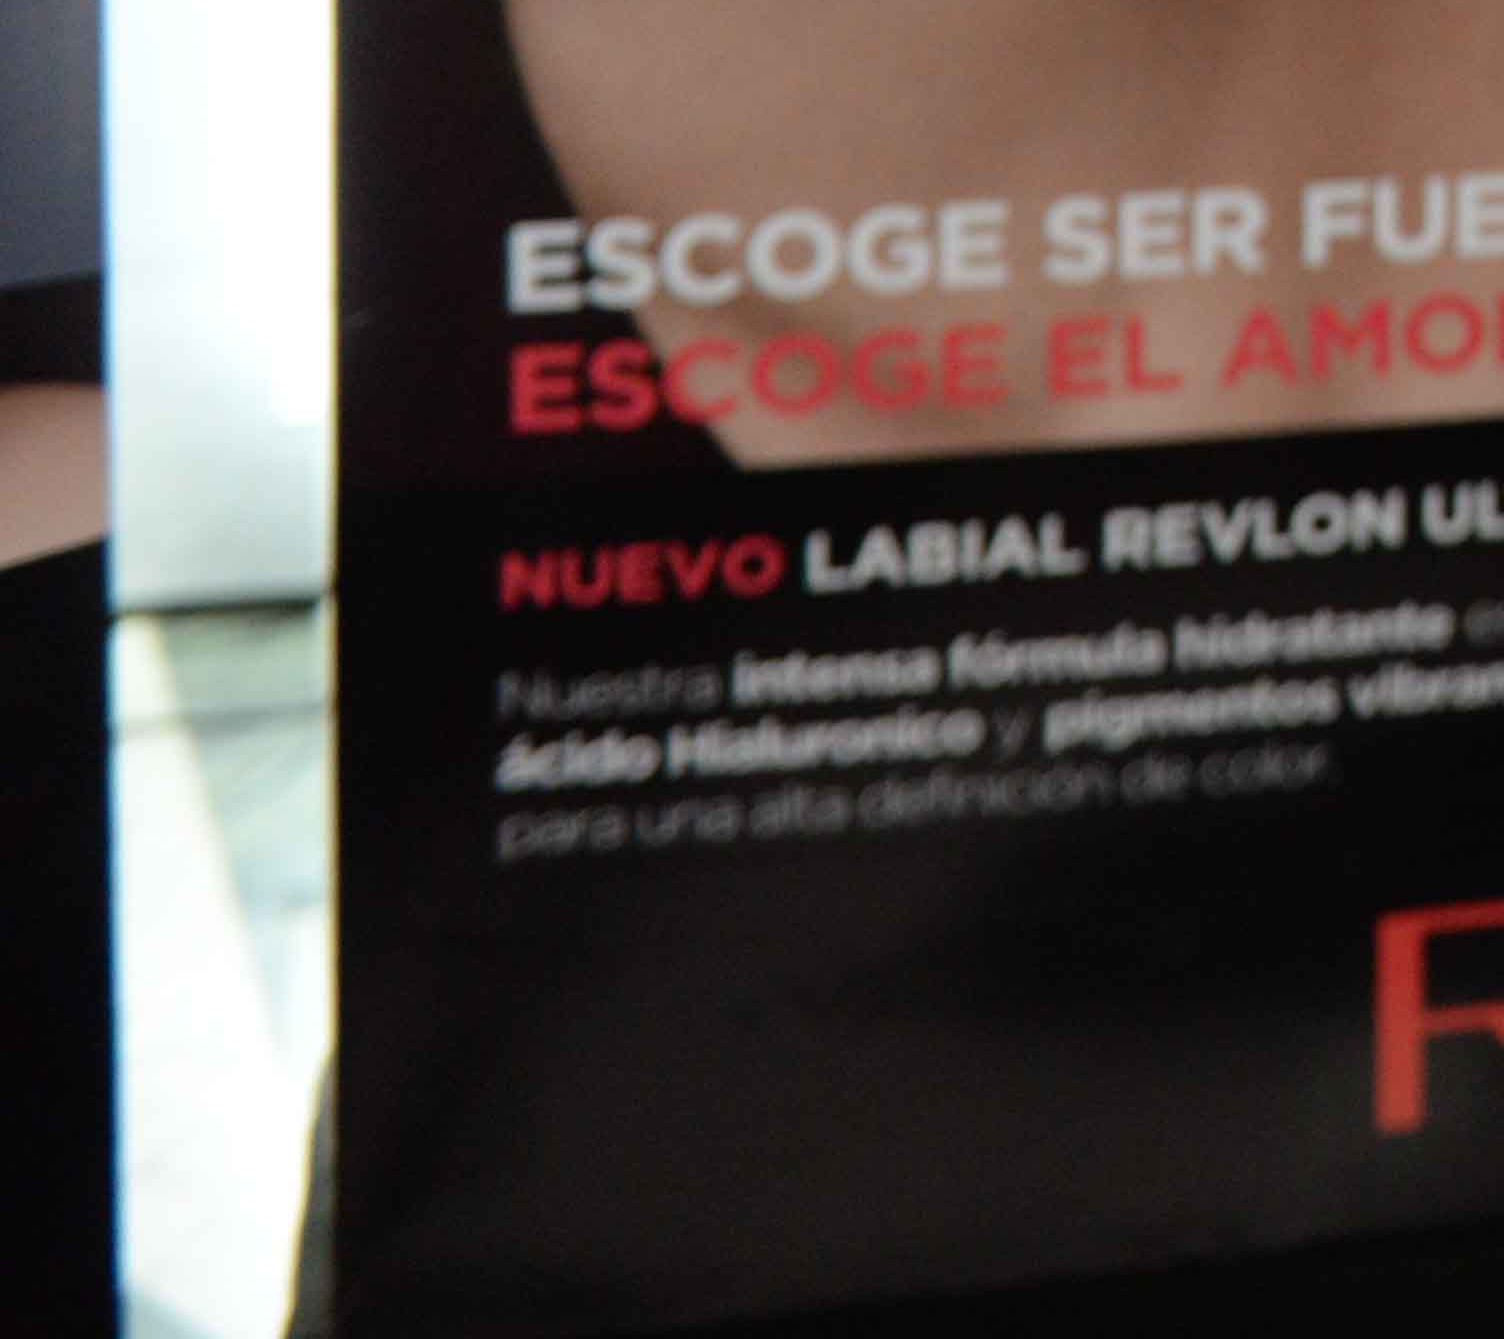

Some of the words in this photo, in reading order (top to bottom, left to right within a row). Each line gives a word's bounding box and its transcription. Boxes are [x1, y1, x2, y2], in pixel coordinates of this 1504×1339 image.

[506, 200, 1009, 314] ESCOGE
[1042, 185, 1268, 284] SER
[510, 323, 1008, 435] ESCOGE
[1044, 315, 1183, 402] EL
[501, 533, 786, 611] NUEVO
[804, 513, 1088, 594] LABIAL
[1101, 484, 1408, 572] REVLON
[500, 661, 724, 721] Nuestra
[731, 648, 940, 708] intensa
[947, 627, 1168, 690] fórmula
[1173, 601, 1455, 671] hidratante
[1043, 676, 1341, 754] pigmentos
